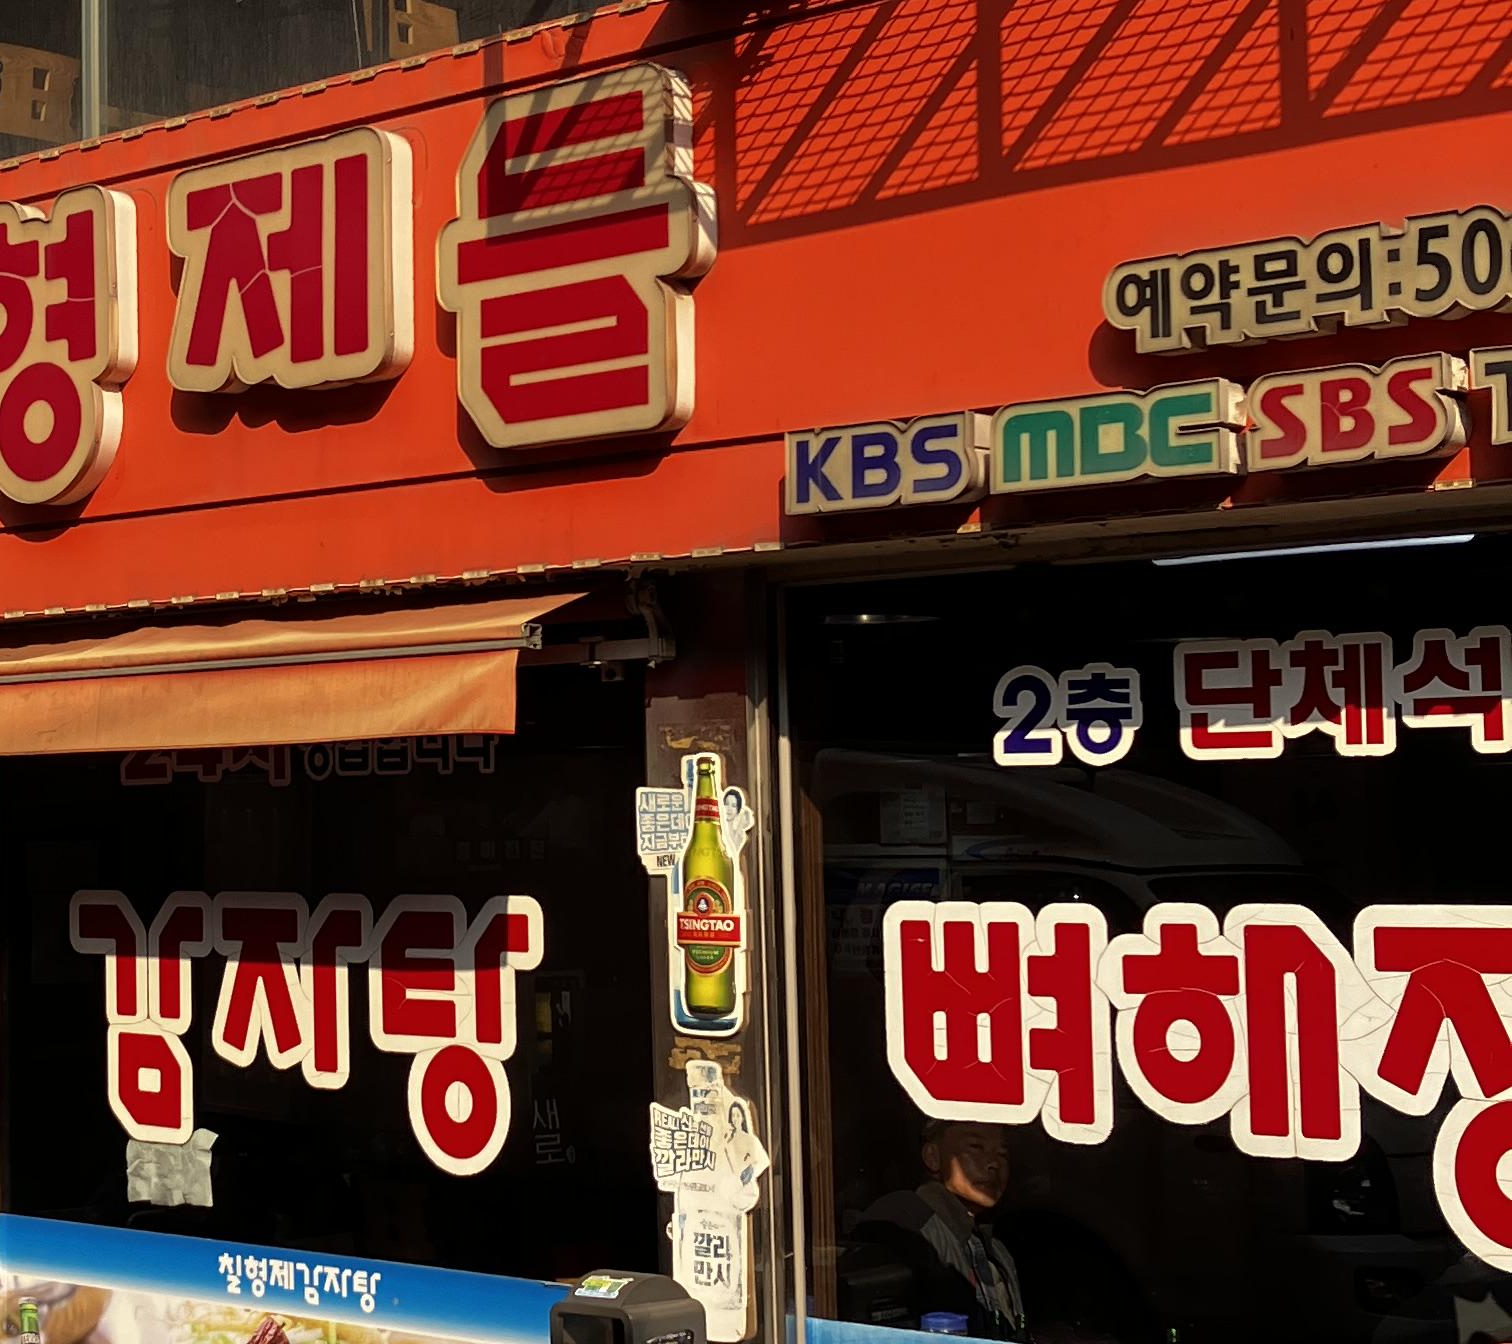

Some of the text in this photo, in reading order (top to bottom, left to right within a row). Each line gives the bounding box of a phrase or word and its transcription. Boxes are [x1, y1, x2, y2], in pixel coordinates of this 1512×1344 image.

[793, 422, 963, 506] KBS
[1001, 390, 1216, 487] MBC
[1258, 365, 1438, 463] SBS
[992, 625, 1512, 767] 2층 단체석
[678, 917, 736, 932] TSINGTAO
[68, 889, 545, 1177] 감자탕
[217, 1251, 383, 1315] 칠형제감자탕
